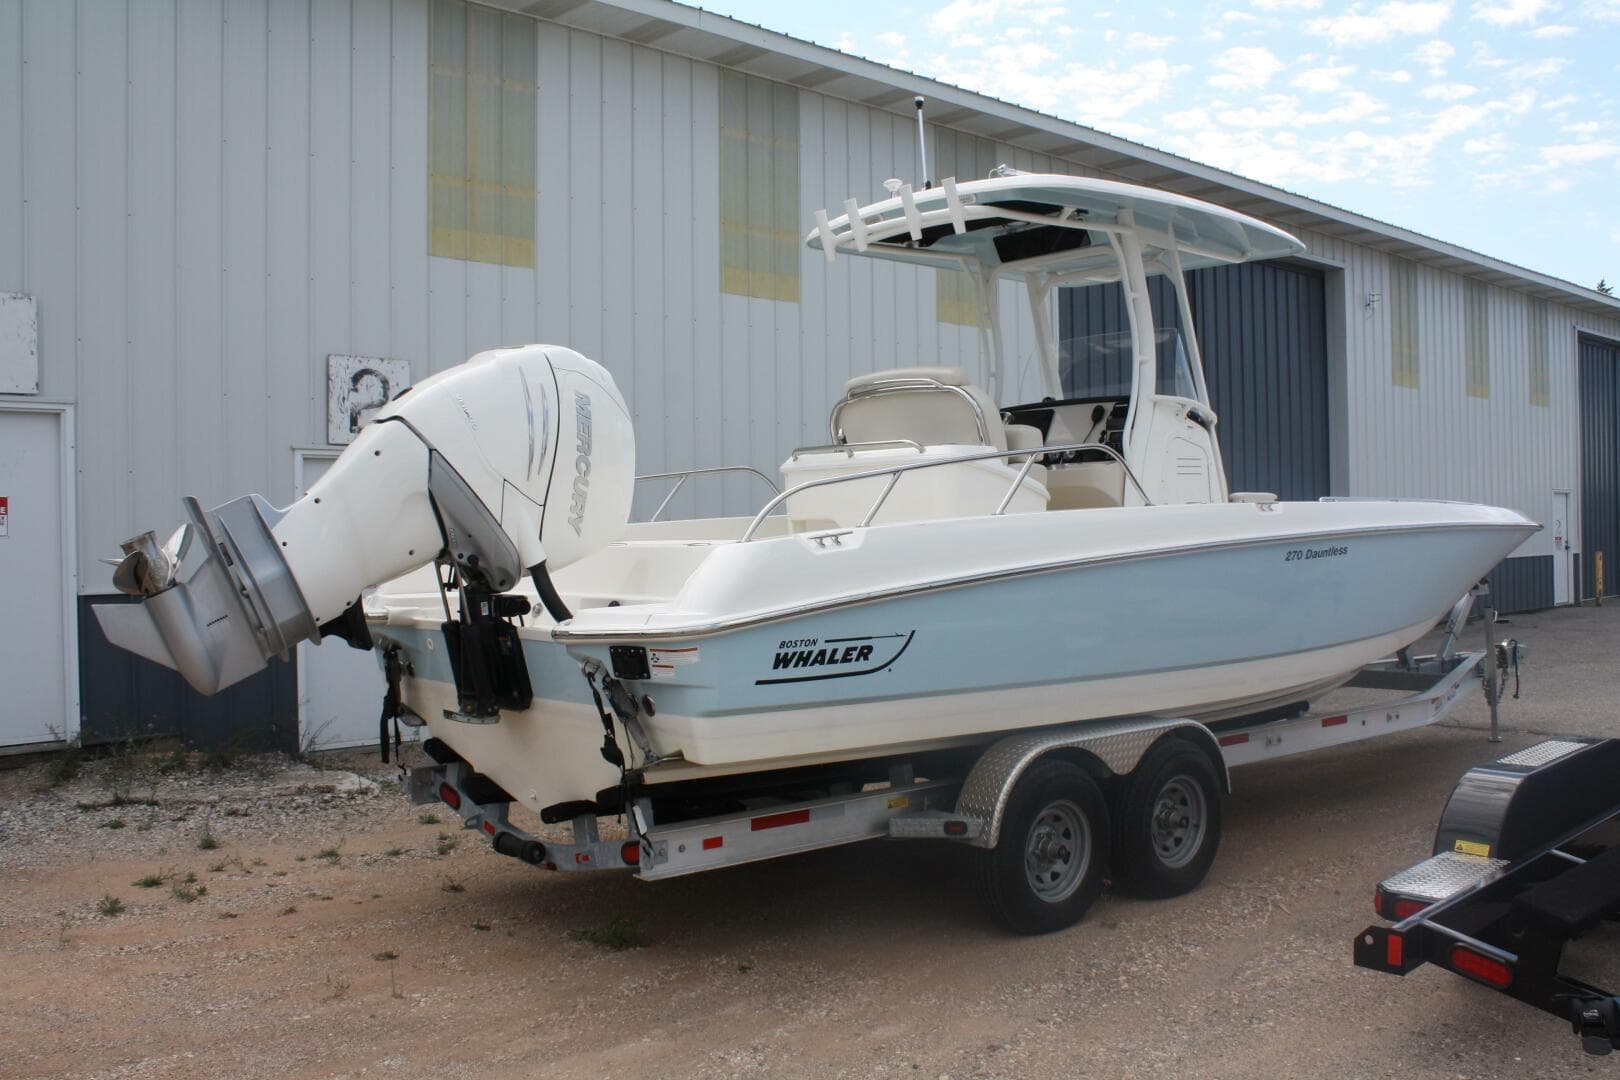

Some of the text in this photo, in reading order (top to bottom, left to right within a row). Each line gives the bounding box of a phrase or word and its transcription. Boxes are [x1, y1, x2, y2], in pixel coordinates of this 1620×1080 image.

[567, 389, 593, 538] MERCURY
[1285, 546, 1348, 561] 270 Dauntless
[778, 638, 818, 649] BOSTON
[772, 645, 874, 670] WHALER
